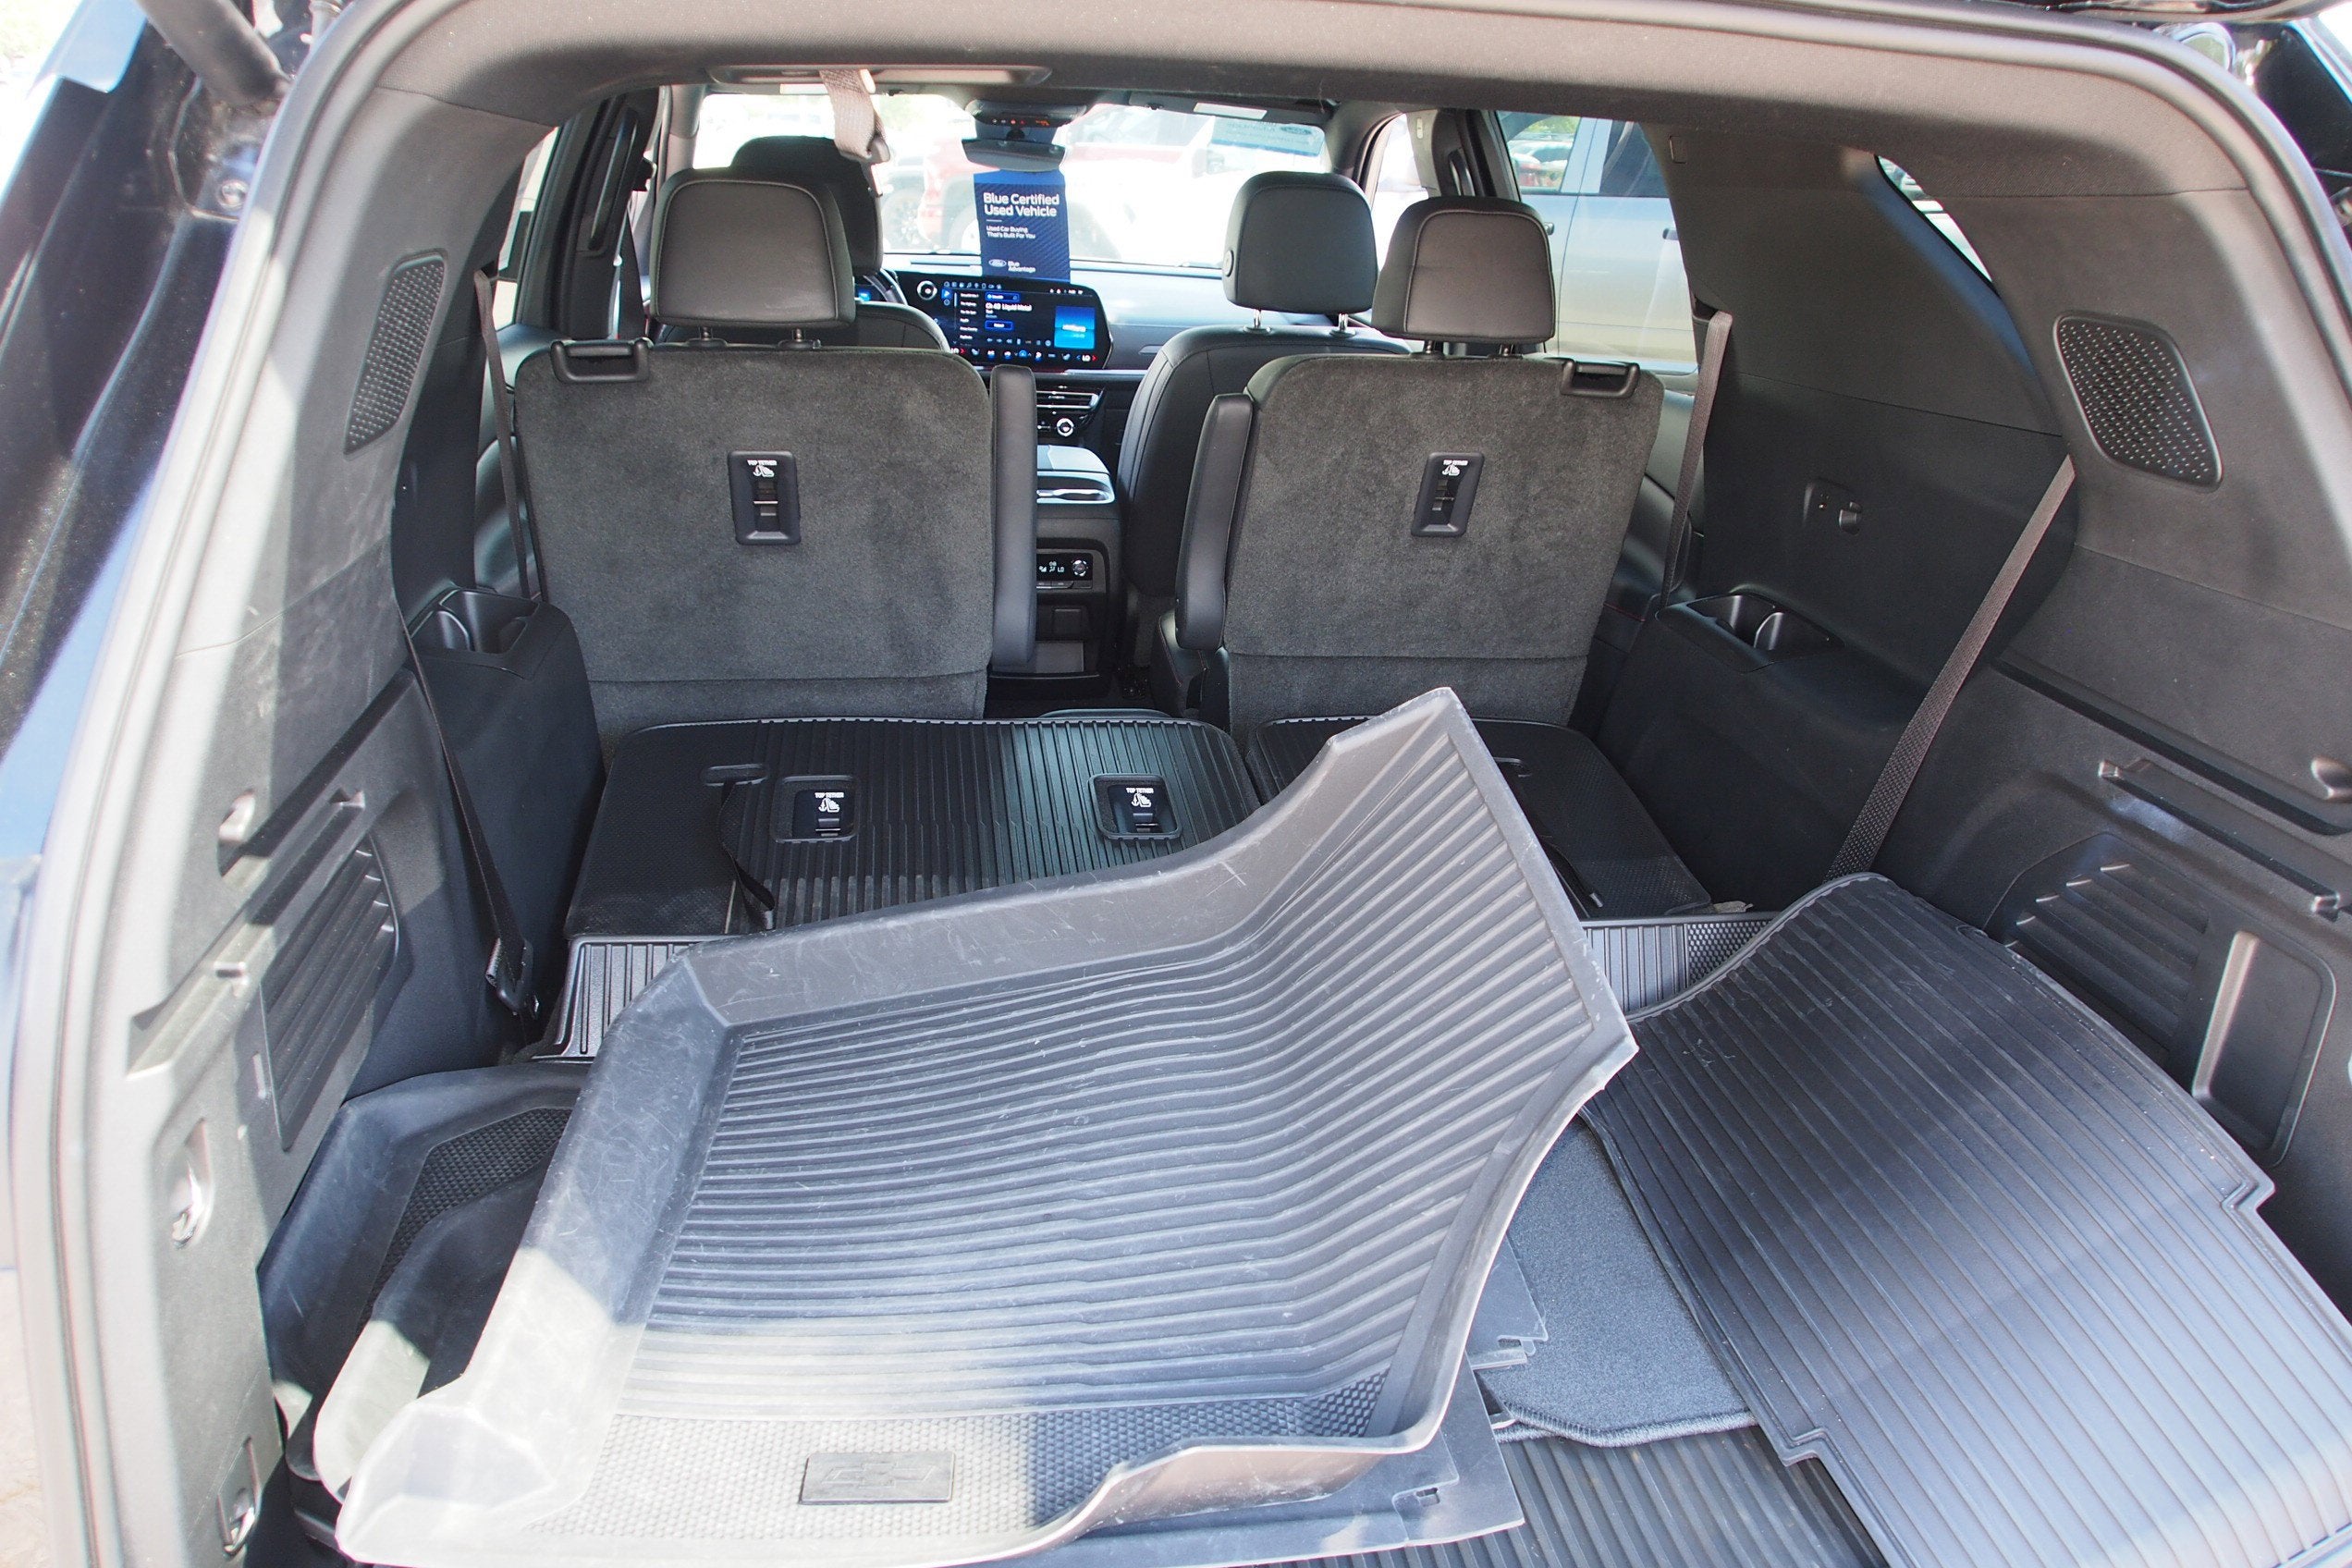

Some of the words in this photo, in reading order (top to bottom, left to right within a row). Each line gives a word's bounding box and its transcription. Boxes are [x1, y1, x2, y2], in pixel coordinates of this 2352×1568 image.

[983, 192, 1009, 204] Blue
[1011, 193, 1060, 205] Certified
[984, 204, 1013, 215] Used
[1015, 205, 1057, 217] Vehicle
